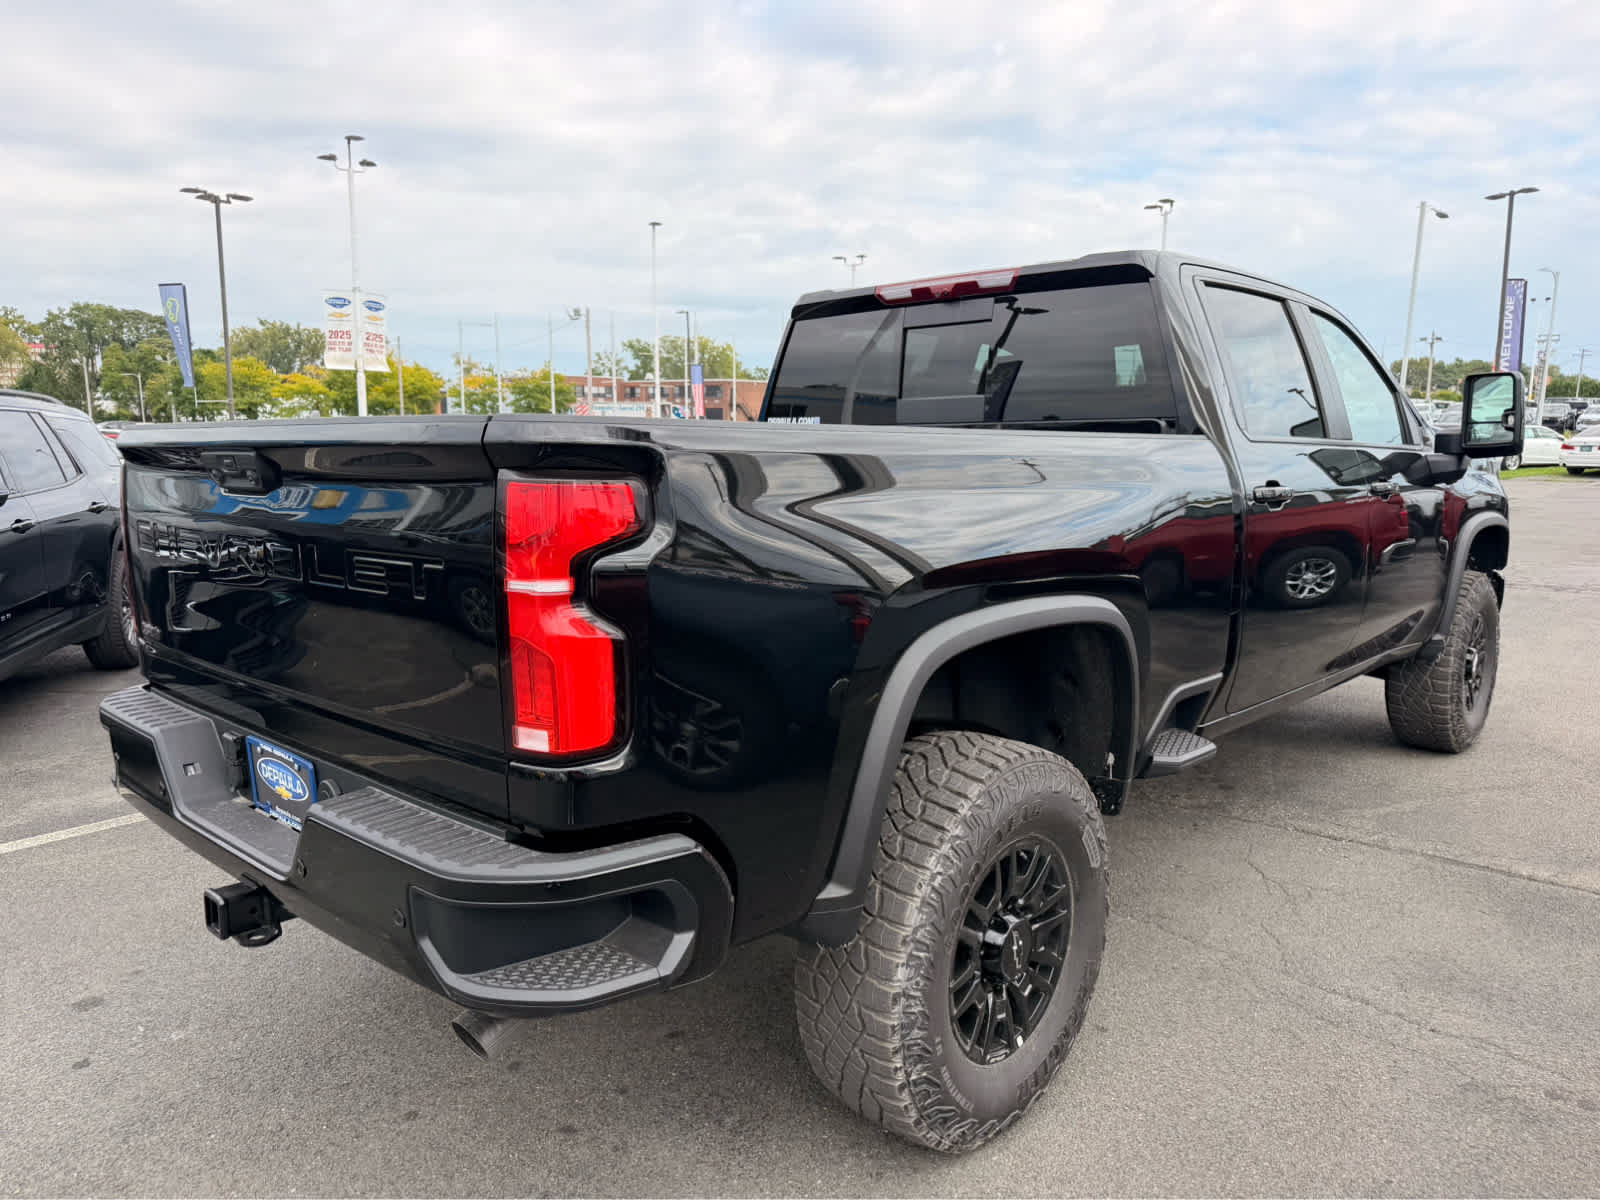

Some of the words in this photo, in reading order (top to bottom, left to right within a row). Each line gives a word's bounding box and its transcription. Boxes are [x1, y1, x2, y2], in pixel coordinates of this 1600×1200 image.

[328, 329, 352, 340] 2025
[137, 519, 445, 600] CHEVROLET
[260, 762, 304, 797] DEPAULA
